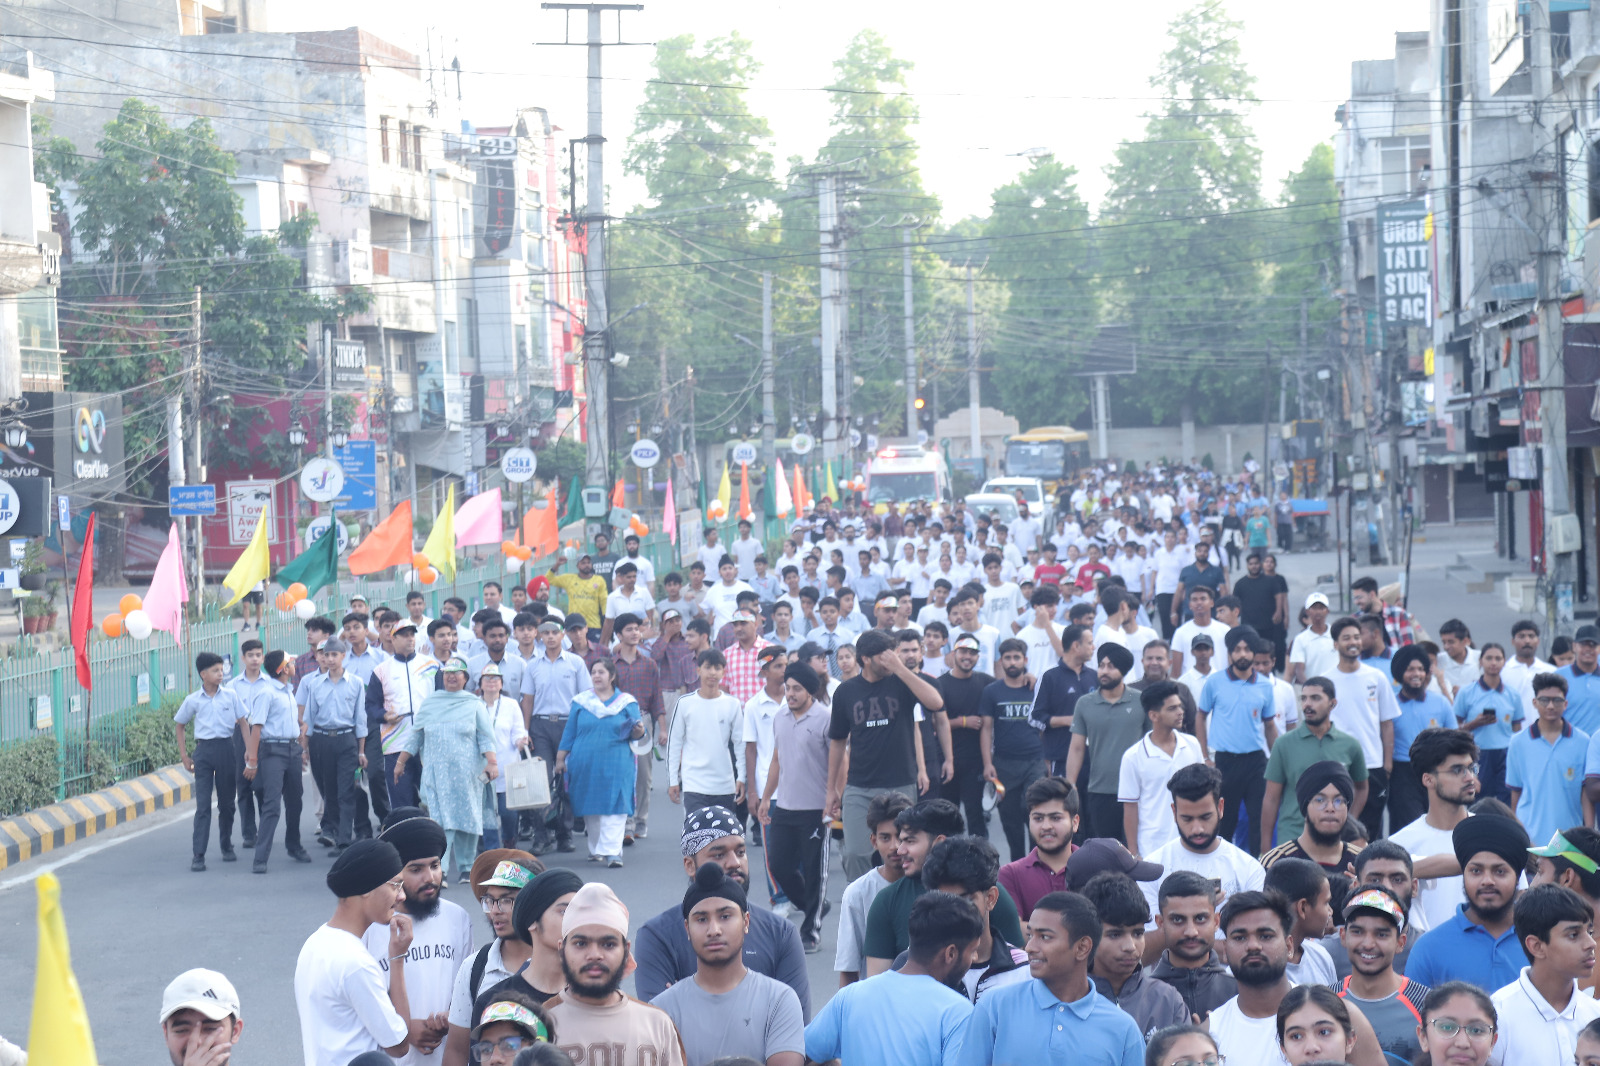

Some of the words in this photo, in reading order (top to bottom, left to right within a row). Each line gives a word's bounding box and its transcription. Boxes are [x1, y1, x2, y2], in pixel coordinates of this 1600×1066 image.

[483, 138, 516, 155] 3D
[76, 460, 109, 479] ClearVue
[508, 457, 530, 467] CIT
[60, 499, 67, 521] P
[240, 504, 263, 515] Tow
[853, 696, 899, 725] GAP
[1005, 704, 1030, 717] NYC
[404, 945, 431, 963] POLO
